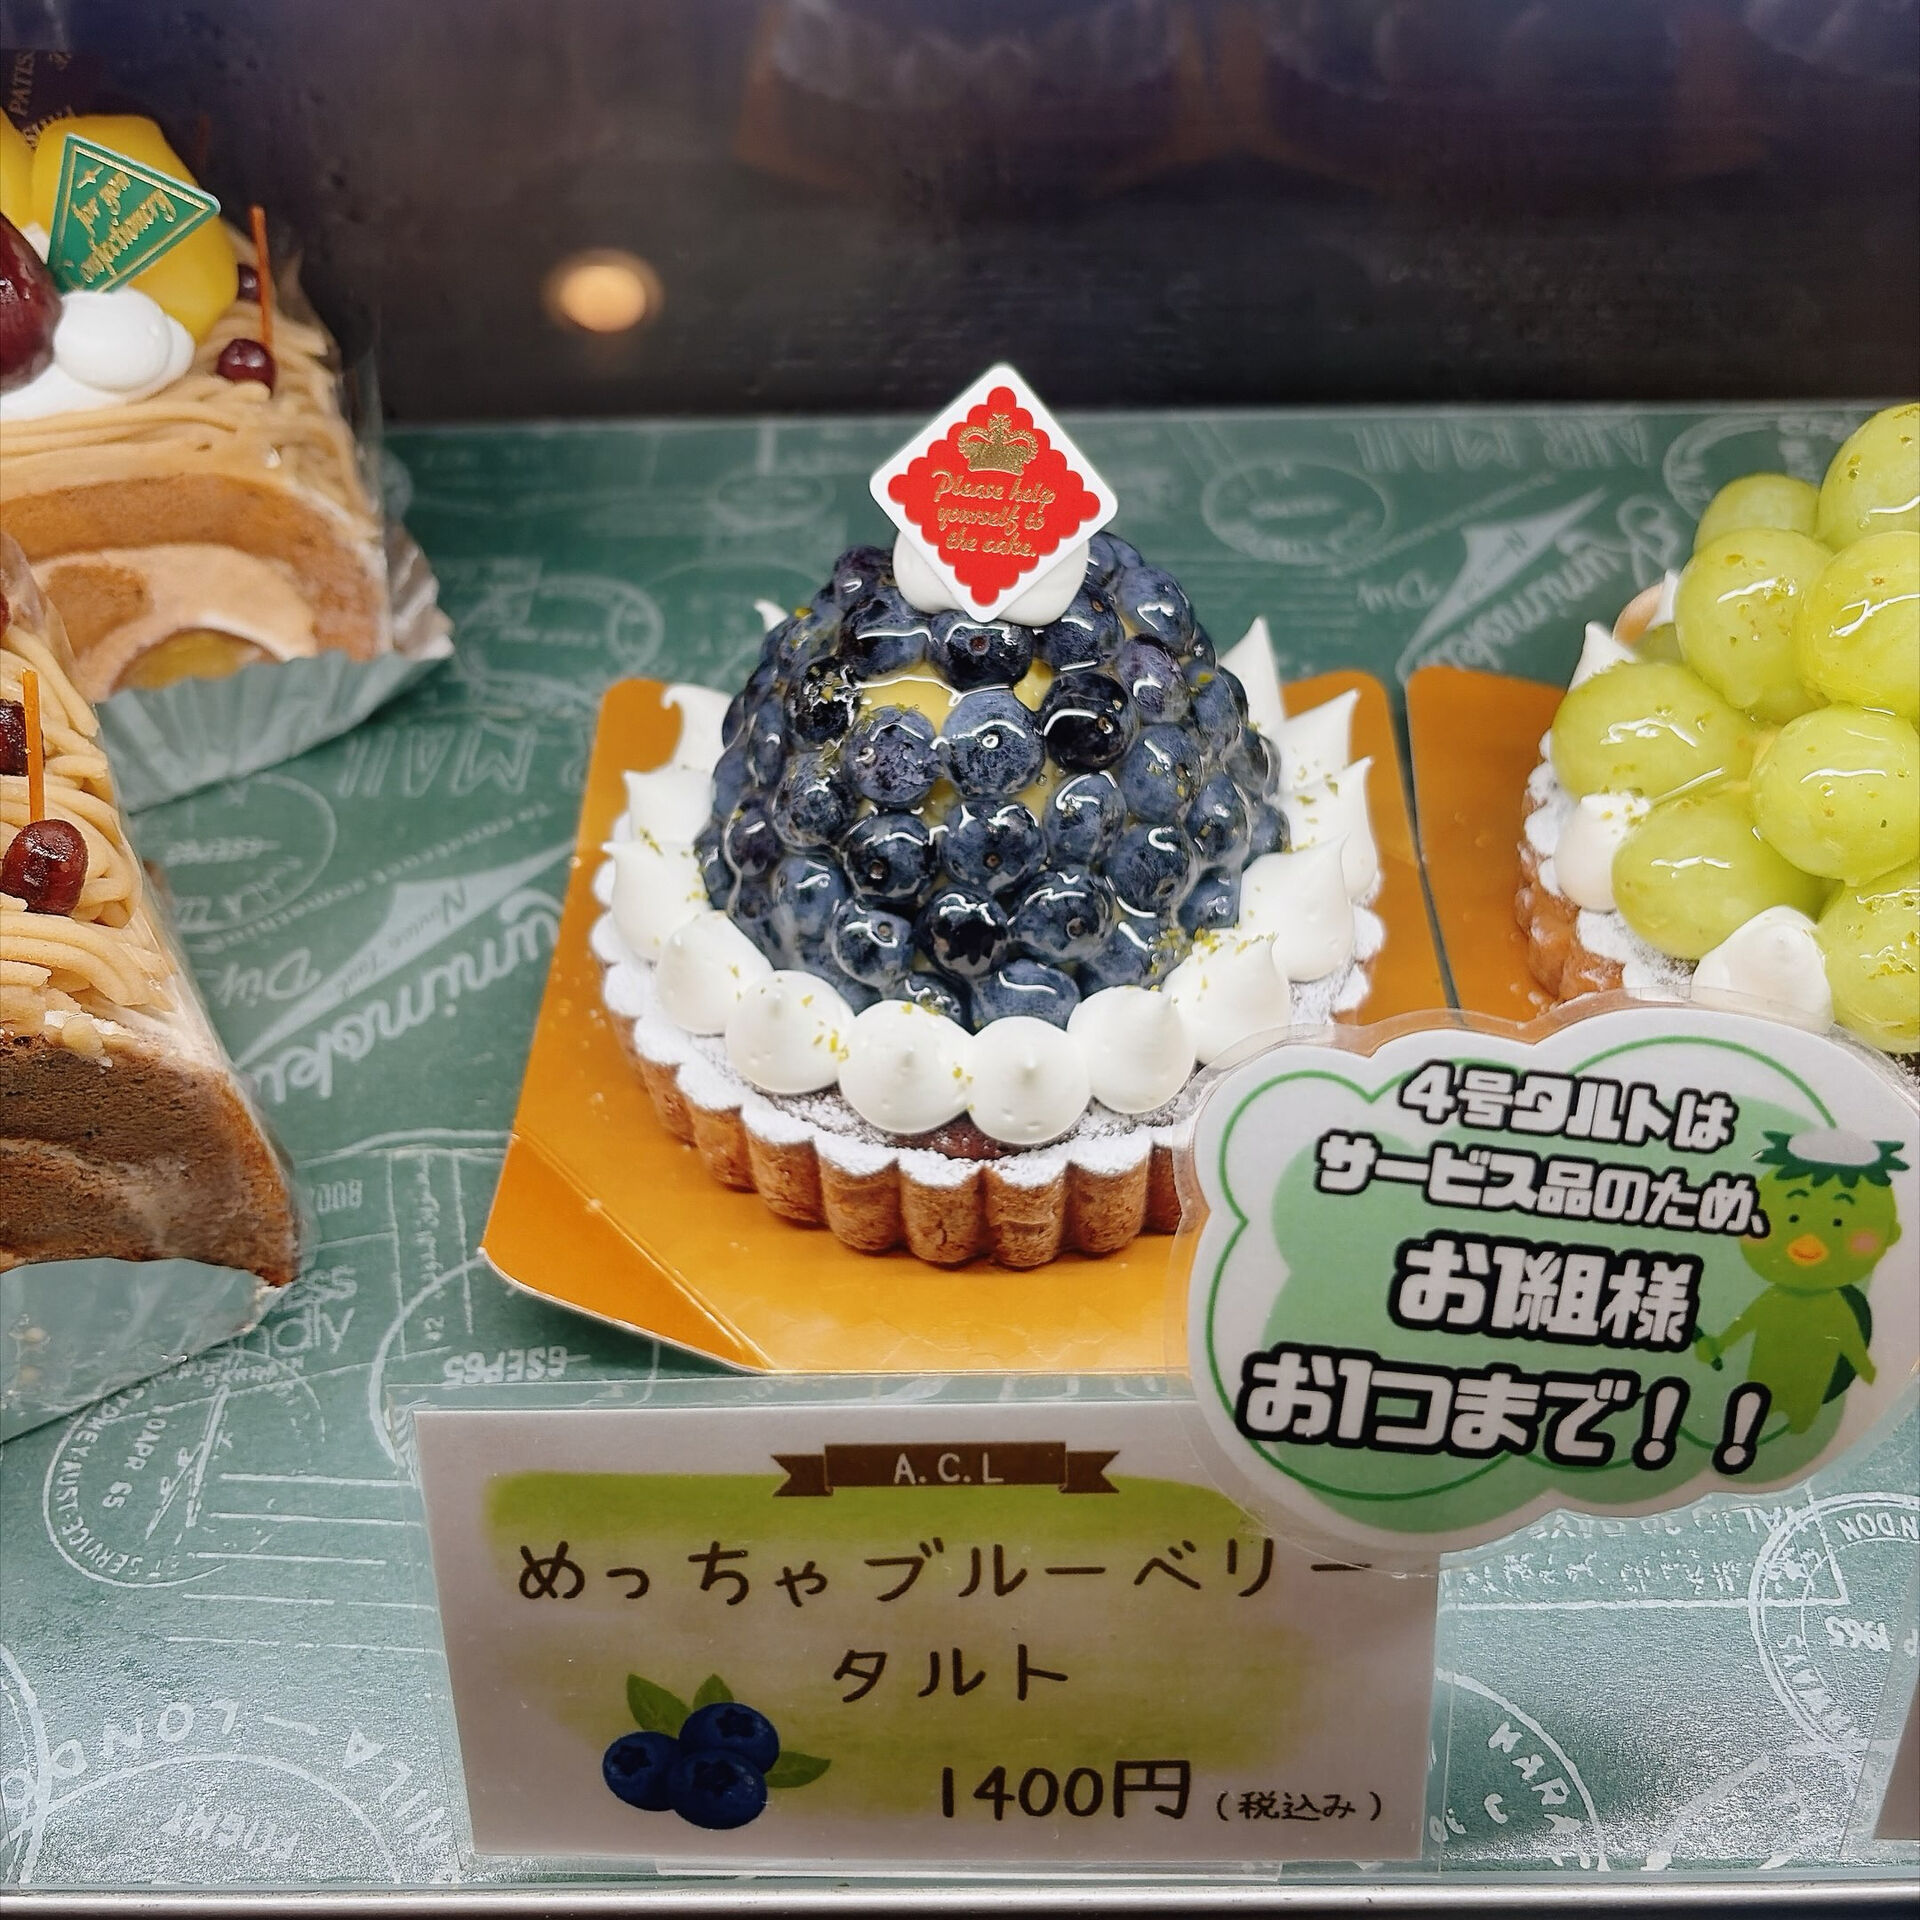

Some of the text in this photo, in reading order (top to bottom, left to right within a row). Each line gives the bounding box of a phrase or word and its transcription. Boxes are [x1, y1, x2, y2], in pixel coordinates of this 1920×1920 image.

[931, 469, 1057, 514] Please help
[937, 503, 1045, 536] yourself to
[946, 527, 977, 551] the
[1399, 1059, 1738, 1153] 4号タルトは
[1317, 1130, 1771, 1238] サービス品のため、
[1391, 1231, 1703, 1352] お1組様
[518, 1537, 1374, 1608] めっちゃブルーベリー
[832, 1645, 1069, 1704] タルト
[940, 1758, 1384, 1823] 1400円 （税込み）
